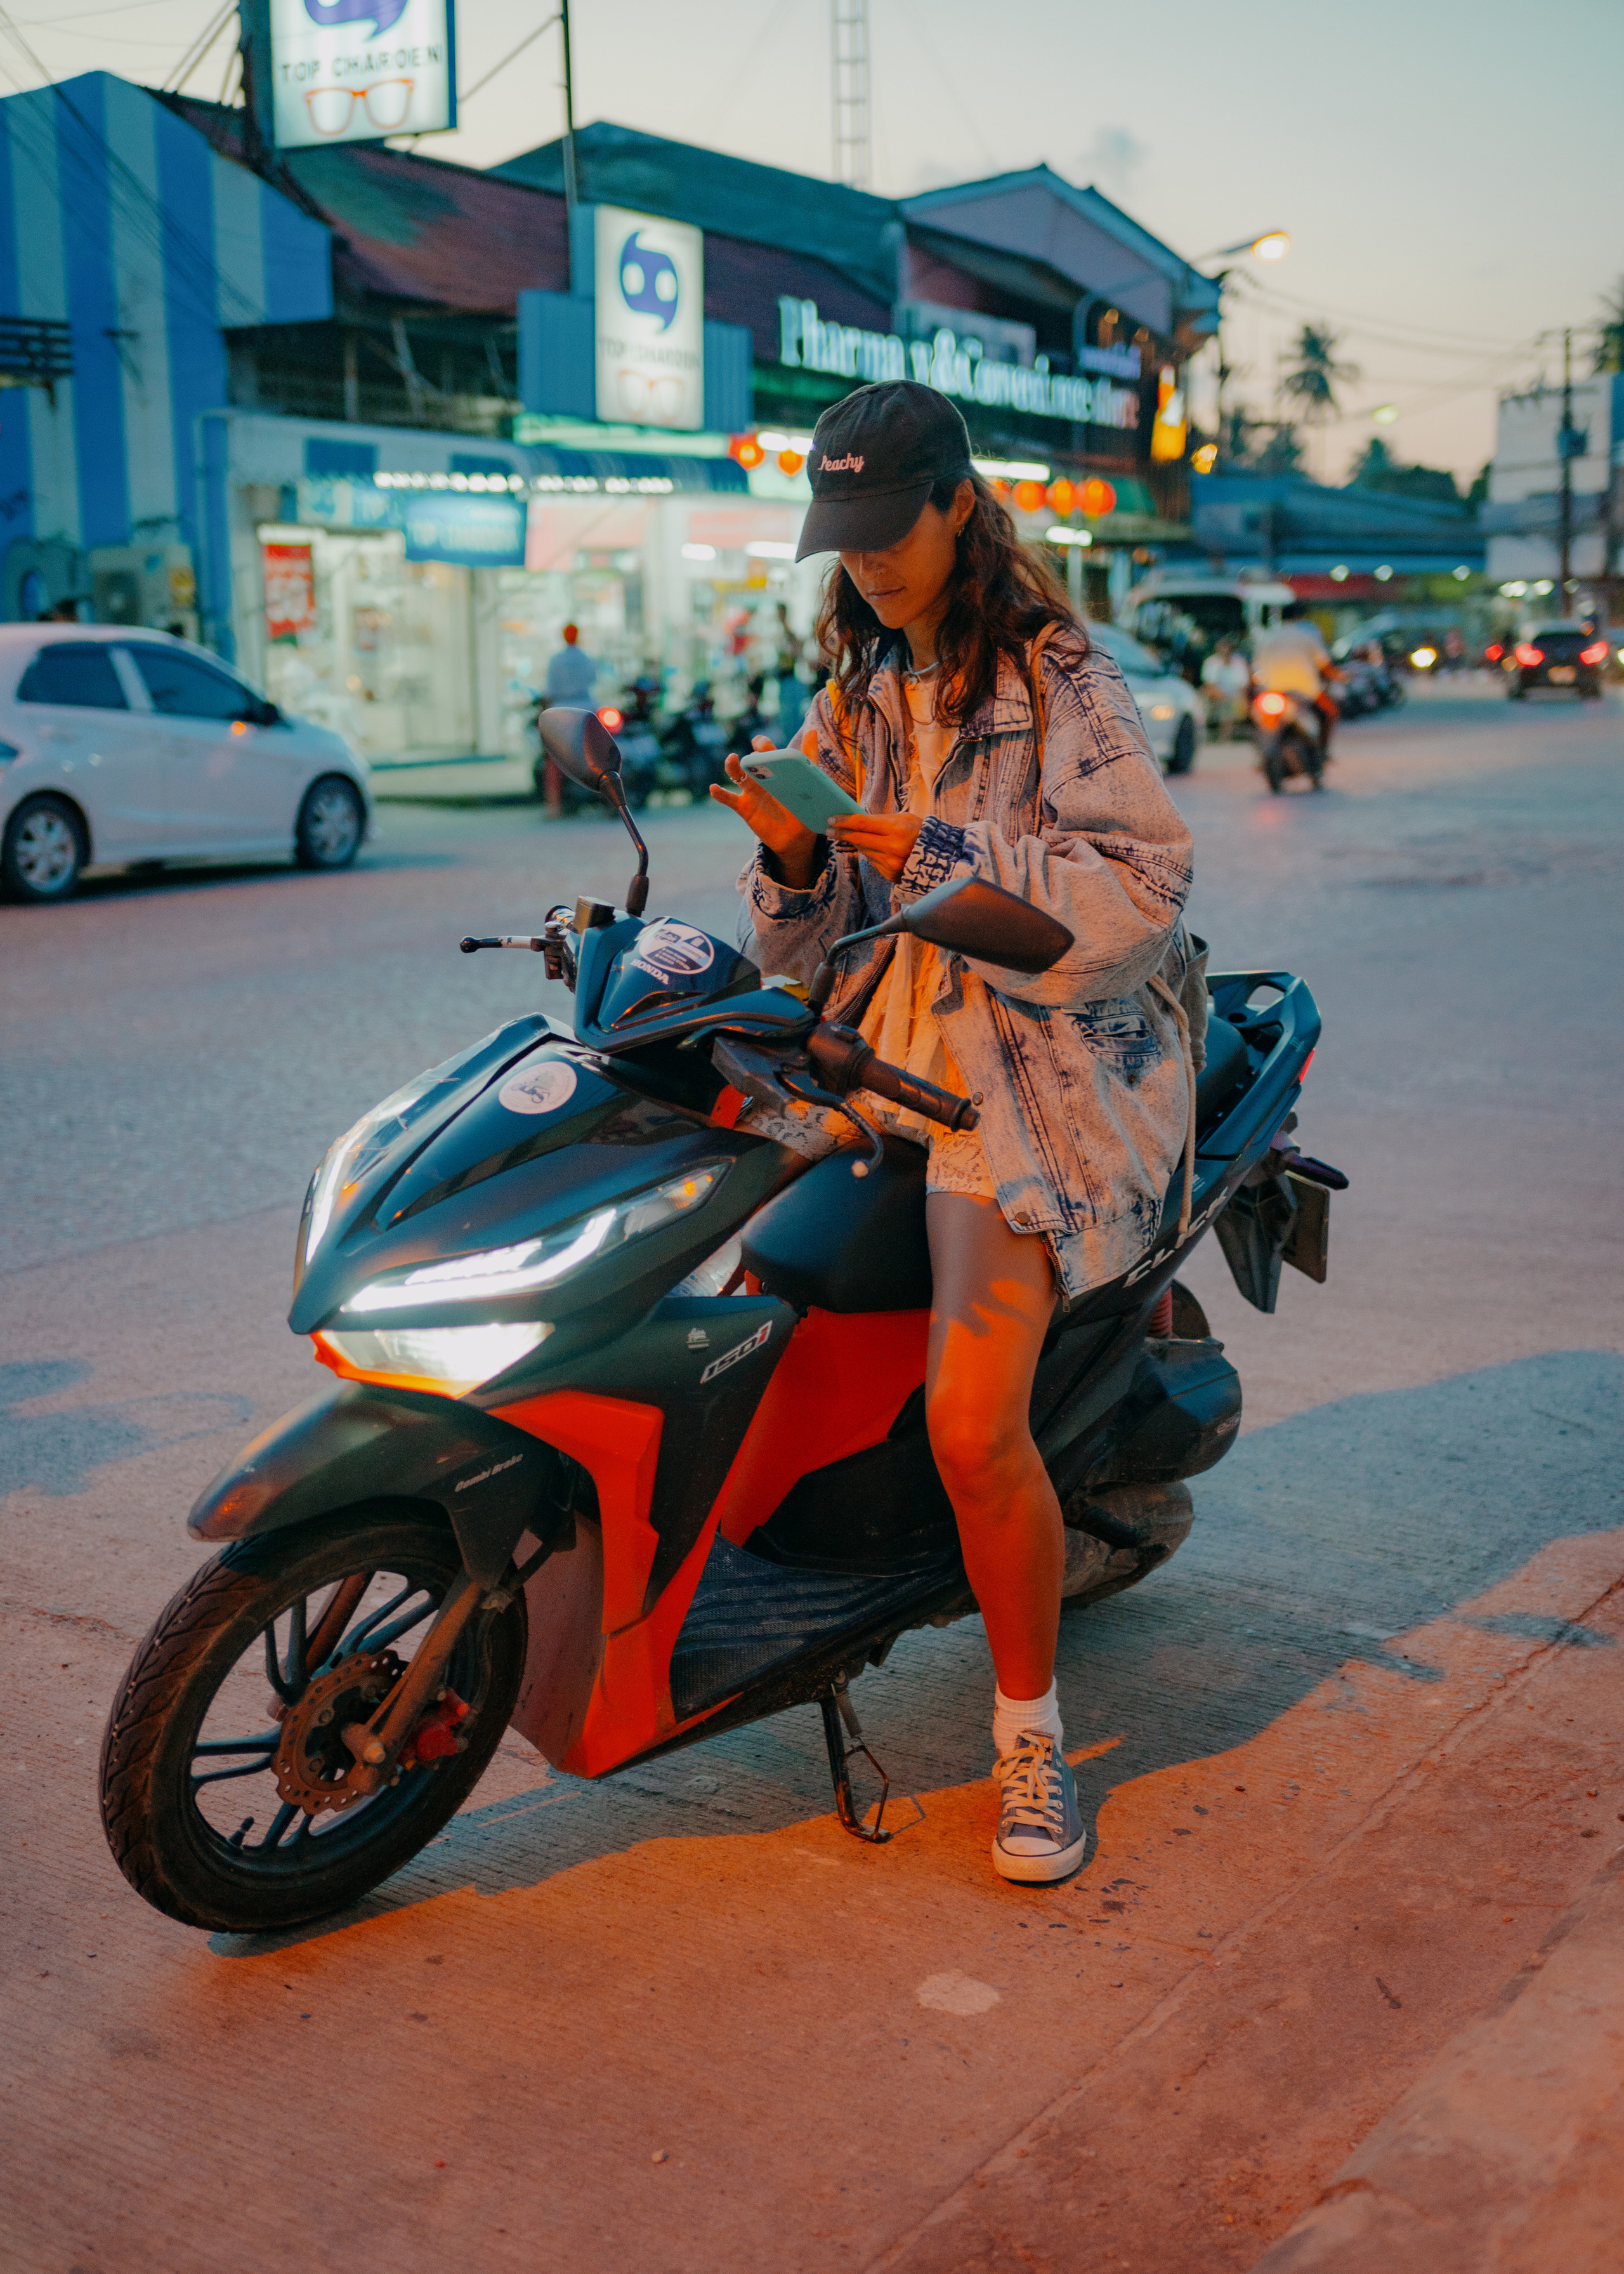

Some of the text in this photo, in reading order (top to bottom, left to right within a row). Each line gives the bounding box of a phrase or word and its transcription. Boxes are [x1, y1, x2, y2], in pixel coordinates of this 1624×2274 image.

[281, 44, 443, 84] TOP CHAROEN
[817, 452, 865, 473] Peachy
[630, 959, 669, 985] HONDA
